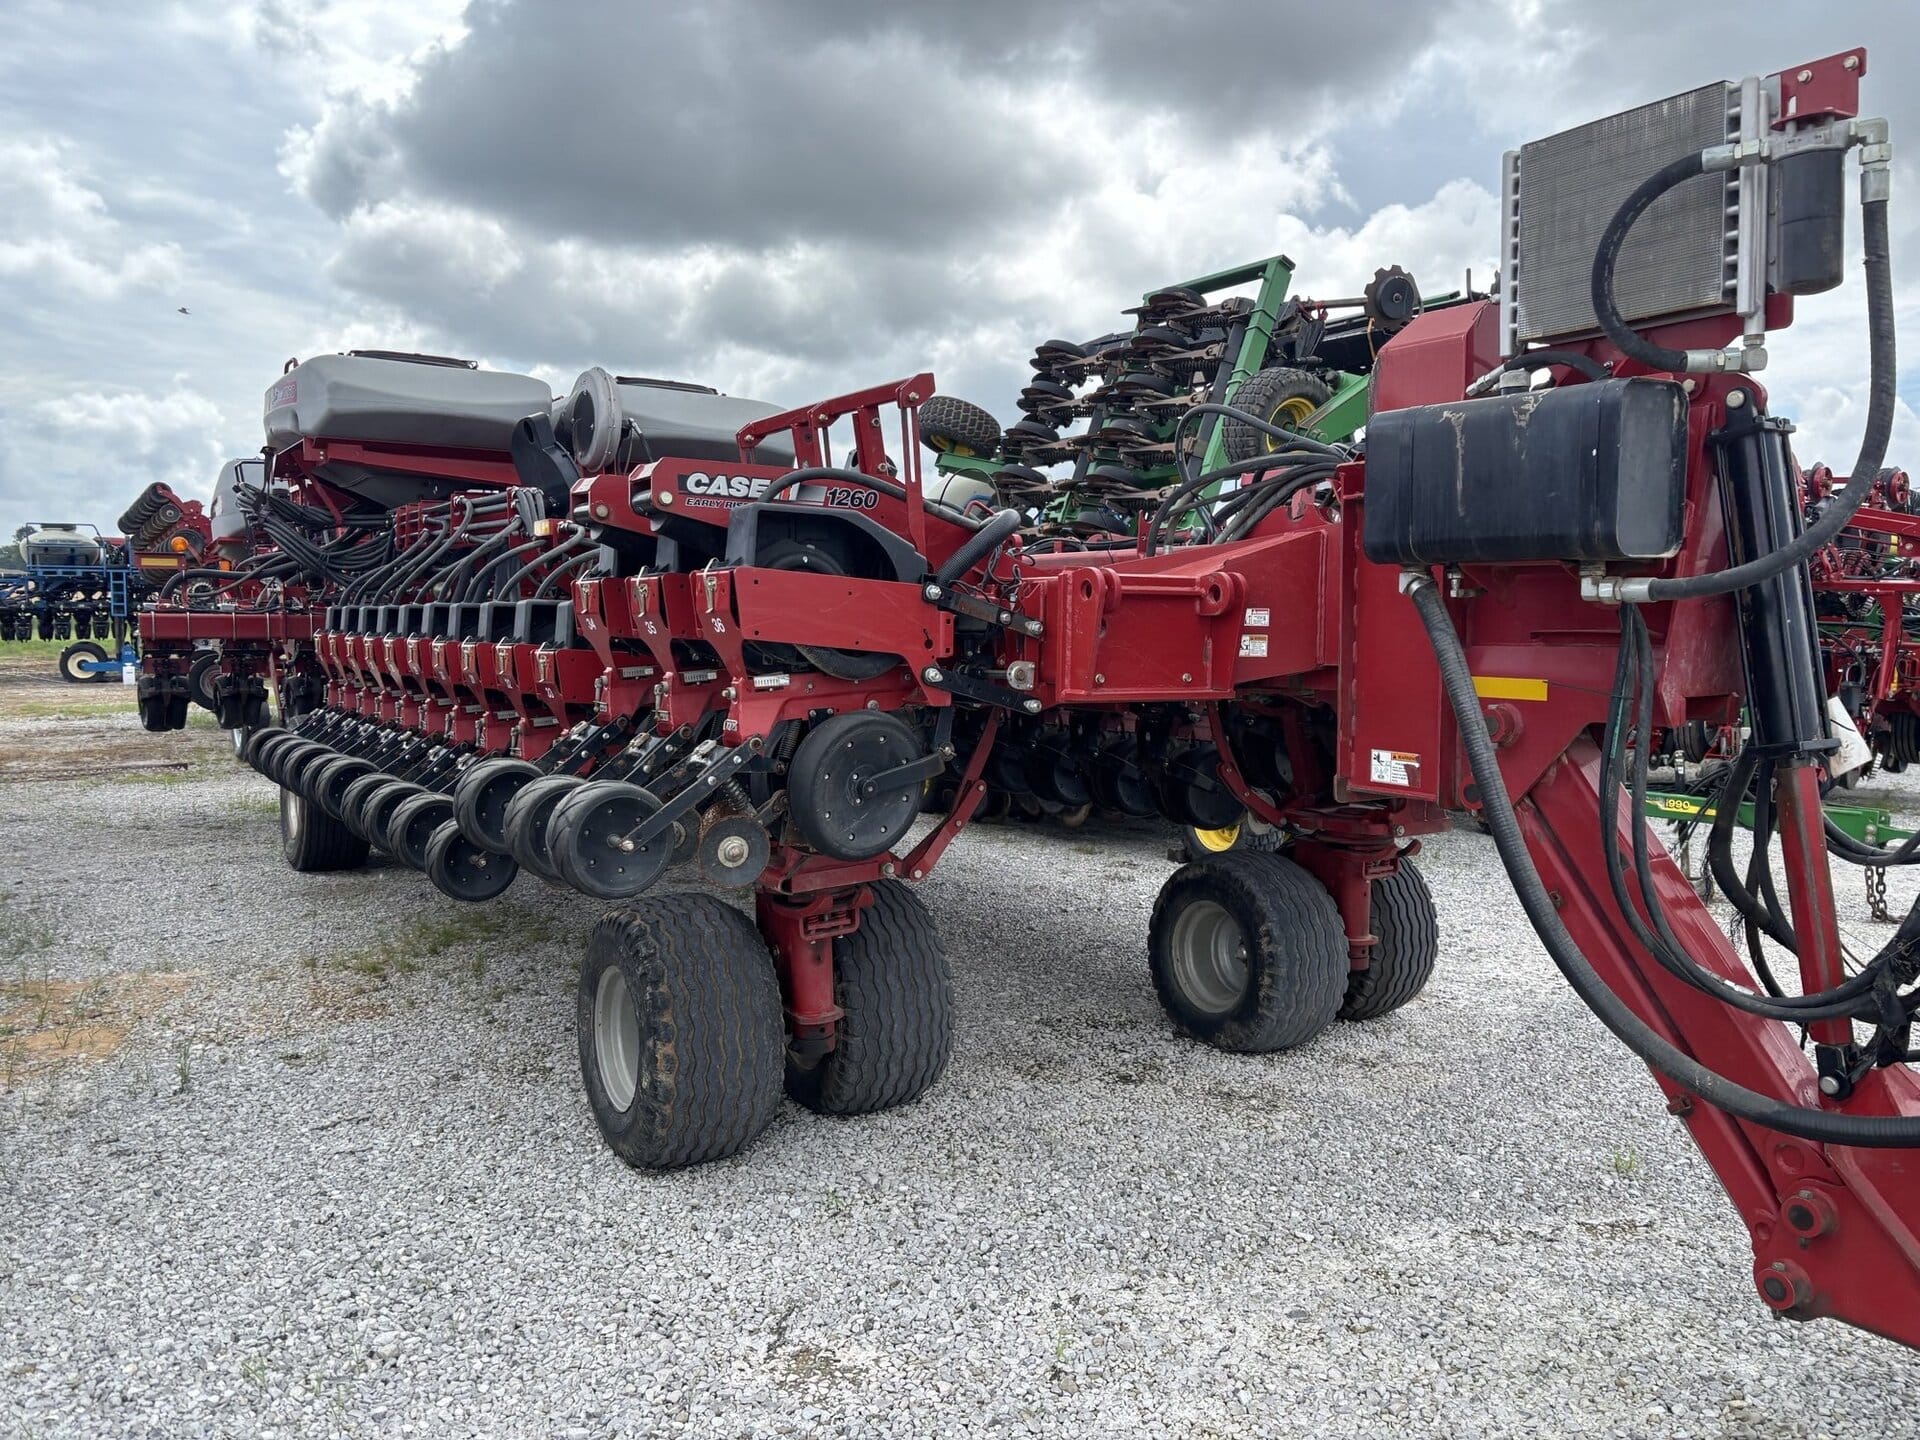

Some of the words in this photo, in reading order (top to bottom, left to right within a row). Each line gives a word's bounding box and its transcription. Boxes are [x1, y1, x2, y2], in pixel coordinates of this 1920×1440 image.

[686, 472, 771, 499] CASE
[685, 497, 723, 509] EARLY
[827, 487, 879, 509] 1260
[585, 617, 597, 631] 34
[644, 620, 657, 635] 35
[711, 617, 726, 633] 36
